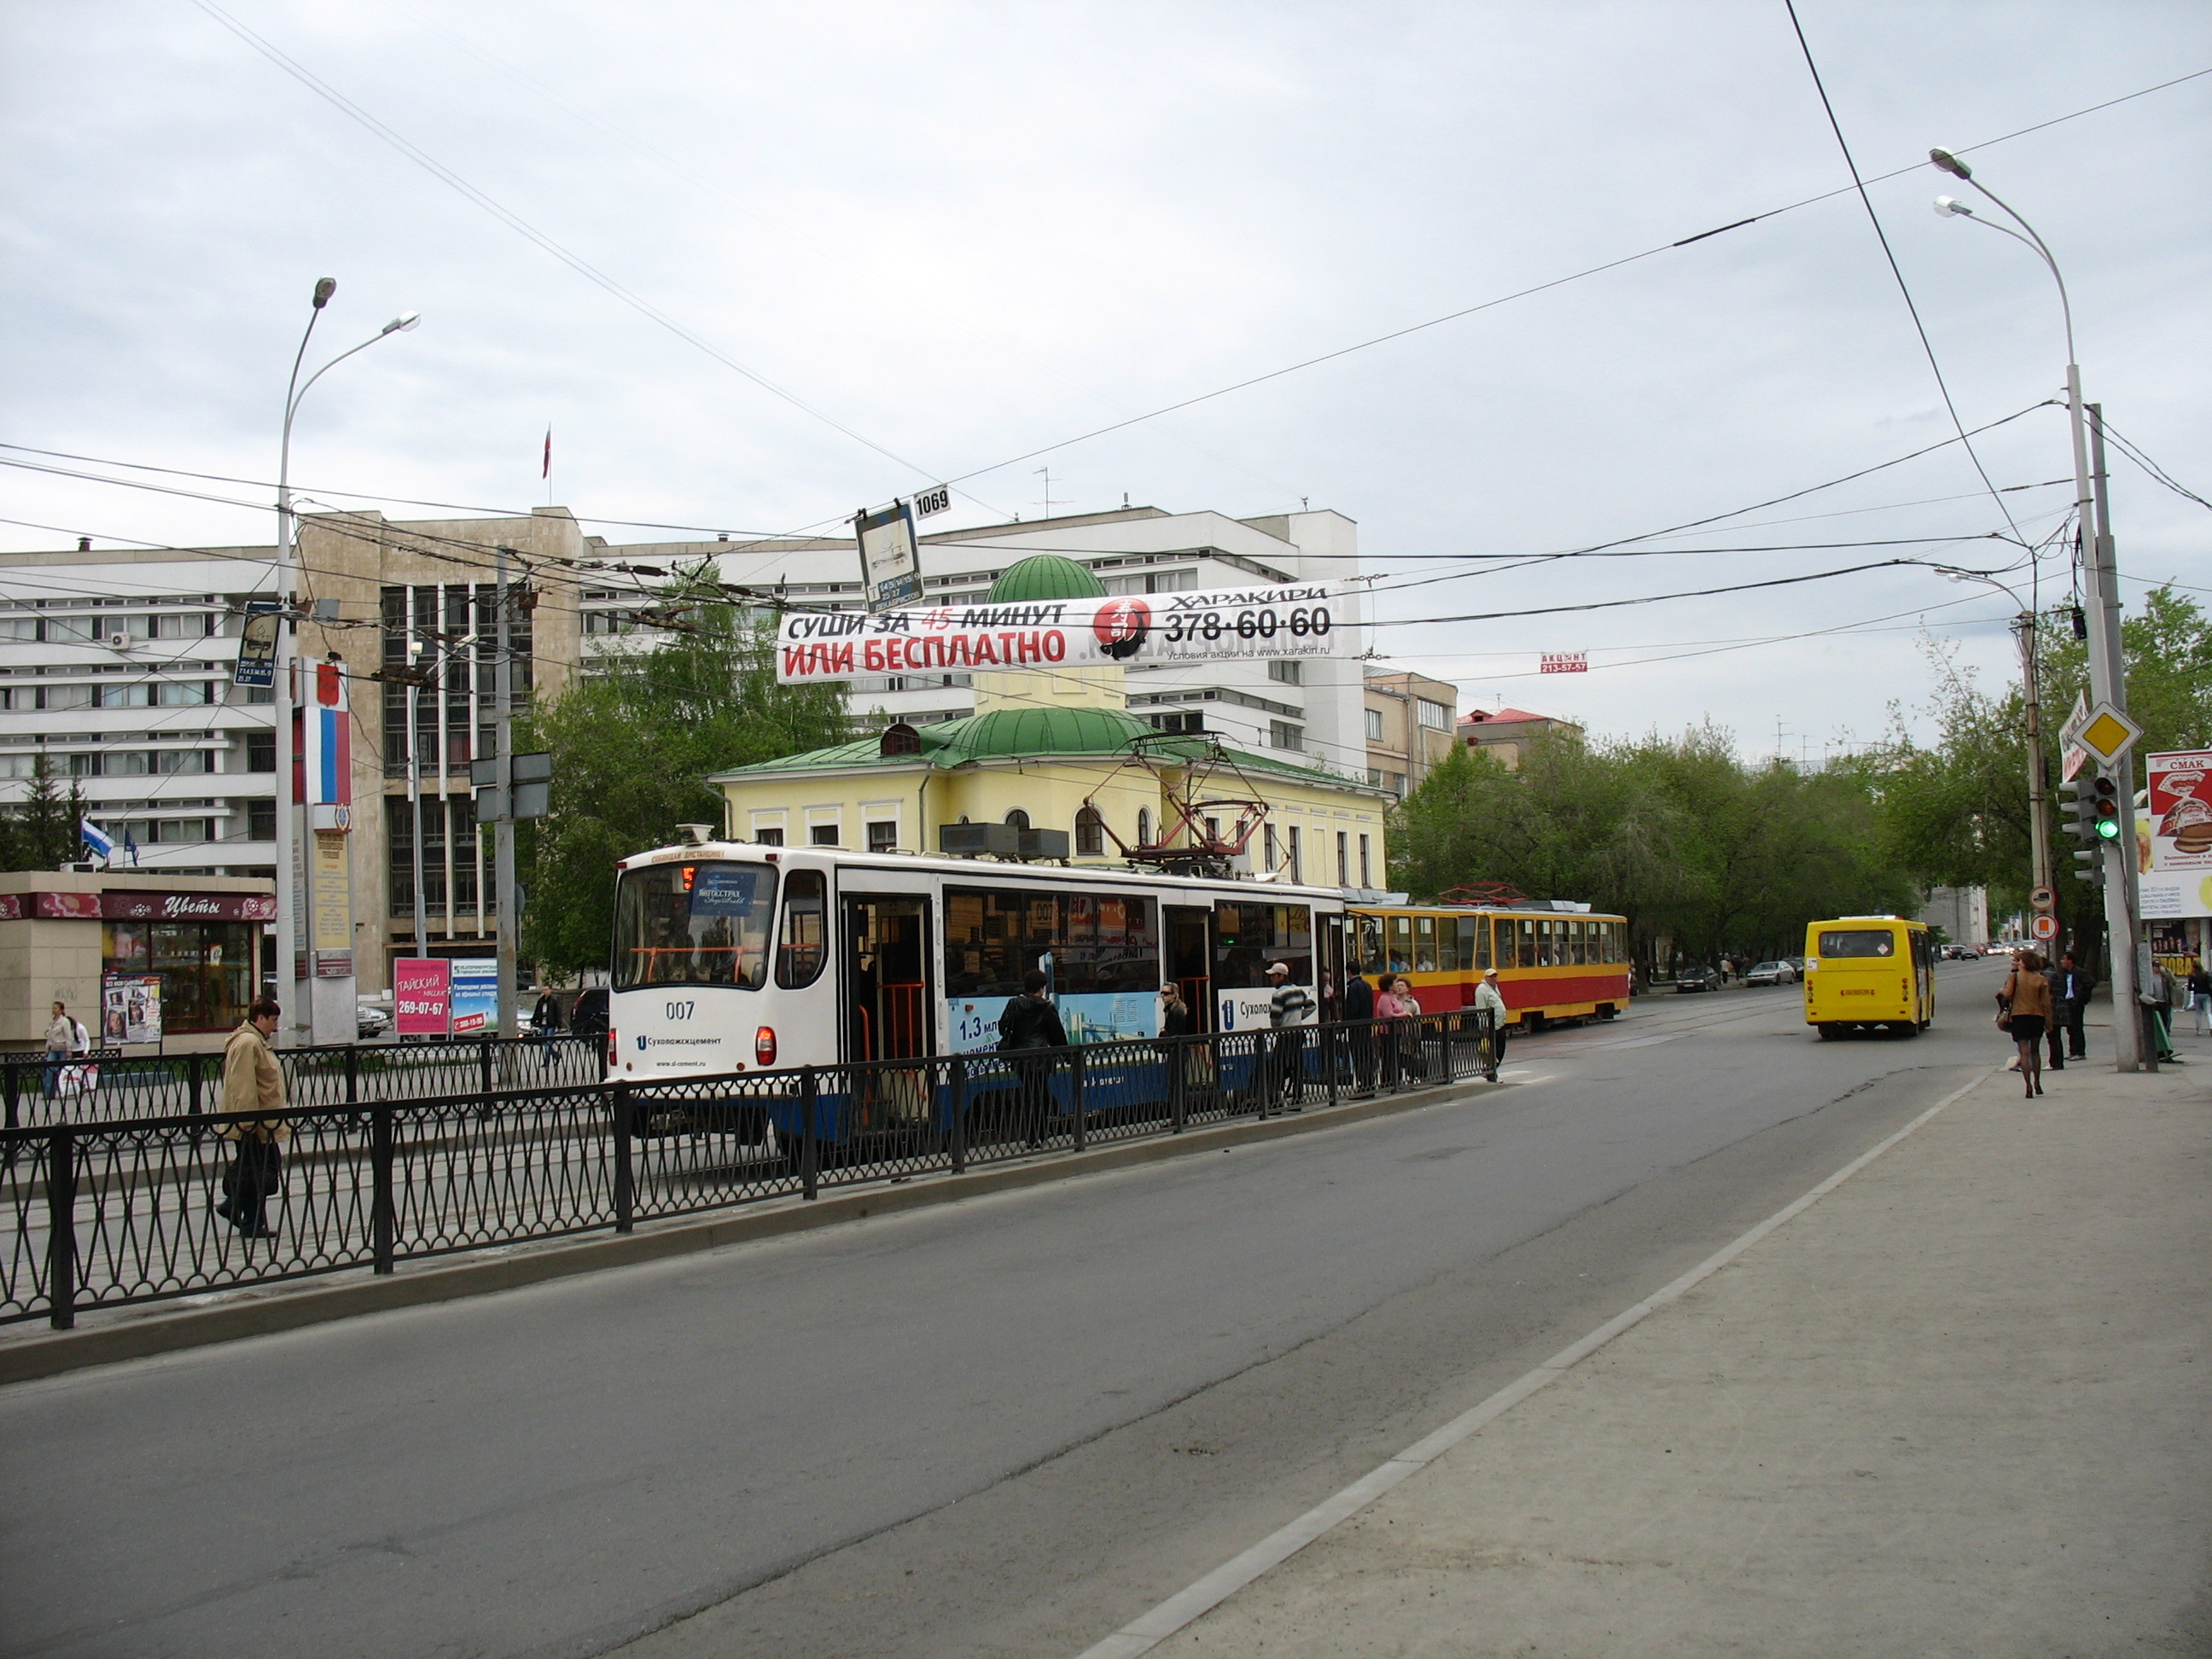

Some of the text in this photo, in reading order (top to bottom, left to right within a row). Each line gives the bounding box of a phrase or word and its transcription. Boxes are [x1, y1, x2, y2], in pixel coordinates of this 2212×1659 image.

[916, 490, 949, 516] 1069
[1167, 586, 1329, 612] ХАРАКИРИ
[788, 604, 1068, 638] СУШИ ЗА 45 МИНУТ
[784, 629, 1067, 677] ИЛИ БЕСПЛАТНО
[1166, 649, 1208, 661] Условия
[2169, 760, 2204, 770] СМАК
[164, 895, 222, 919] Цветы
[397, 974, 439, 992] ТАЙСКИЙ
[399, 1000, 444, 1016] 269-07-67
[666, 1000, 696, 1021] 007
[959, 1016, 999, 1041] 1.3 мл
